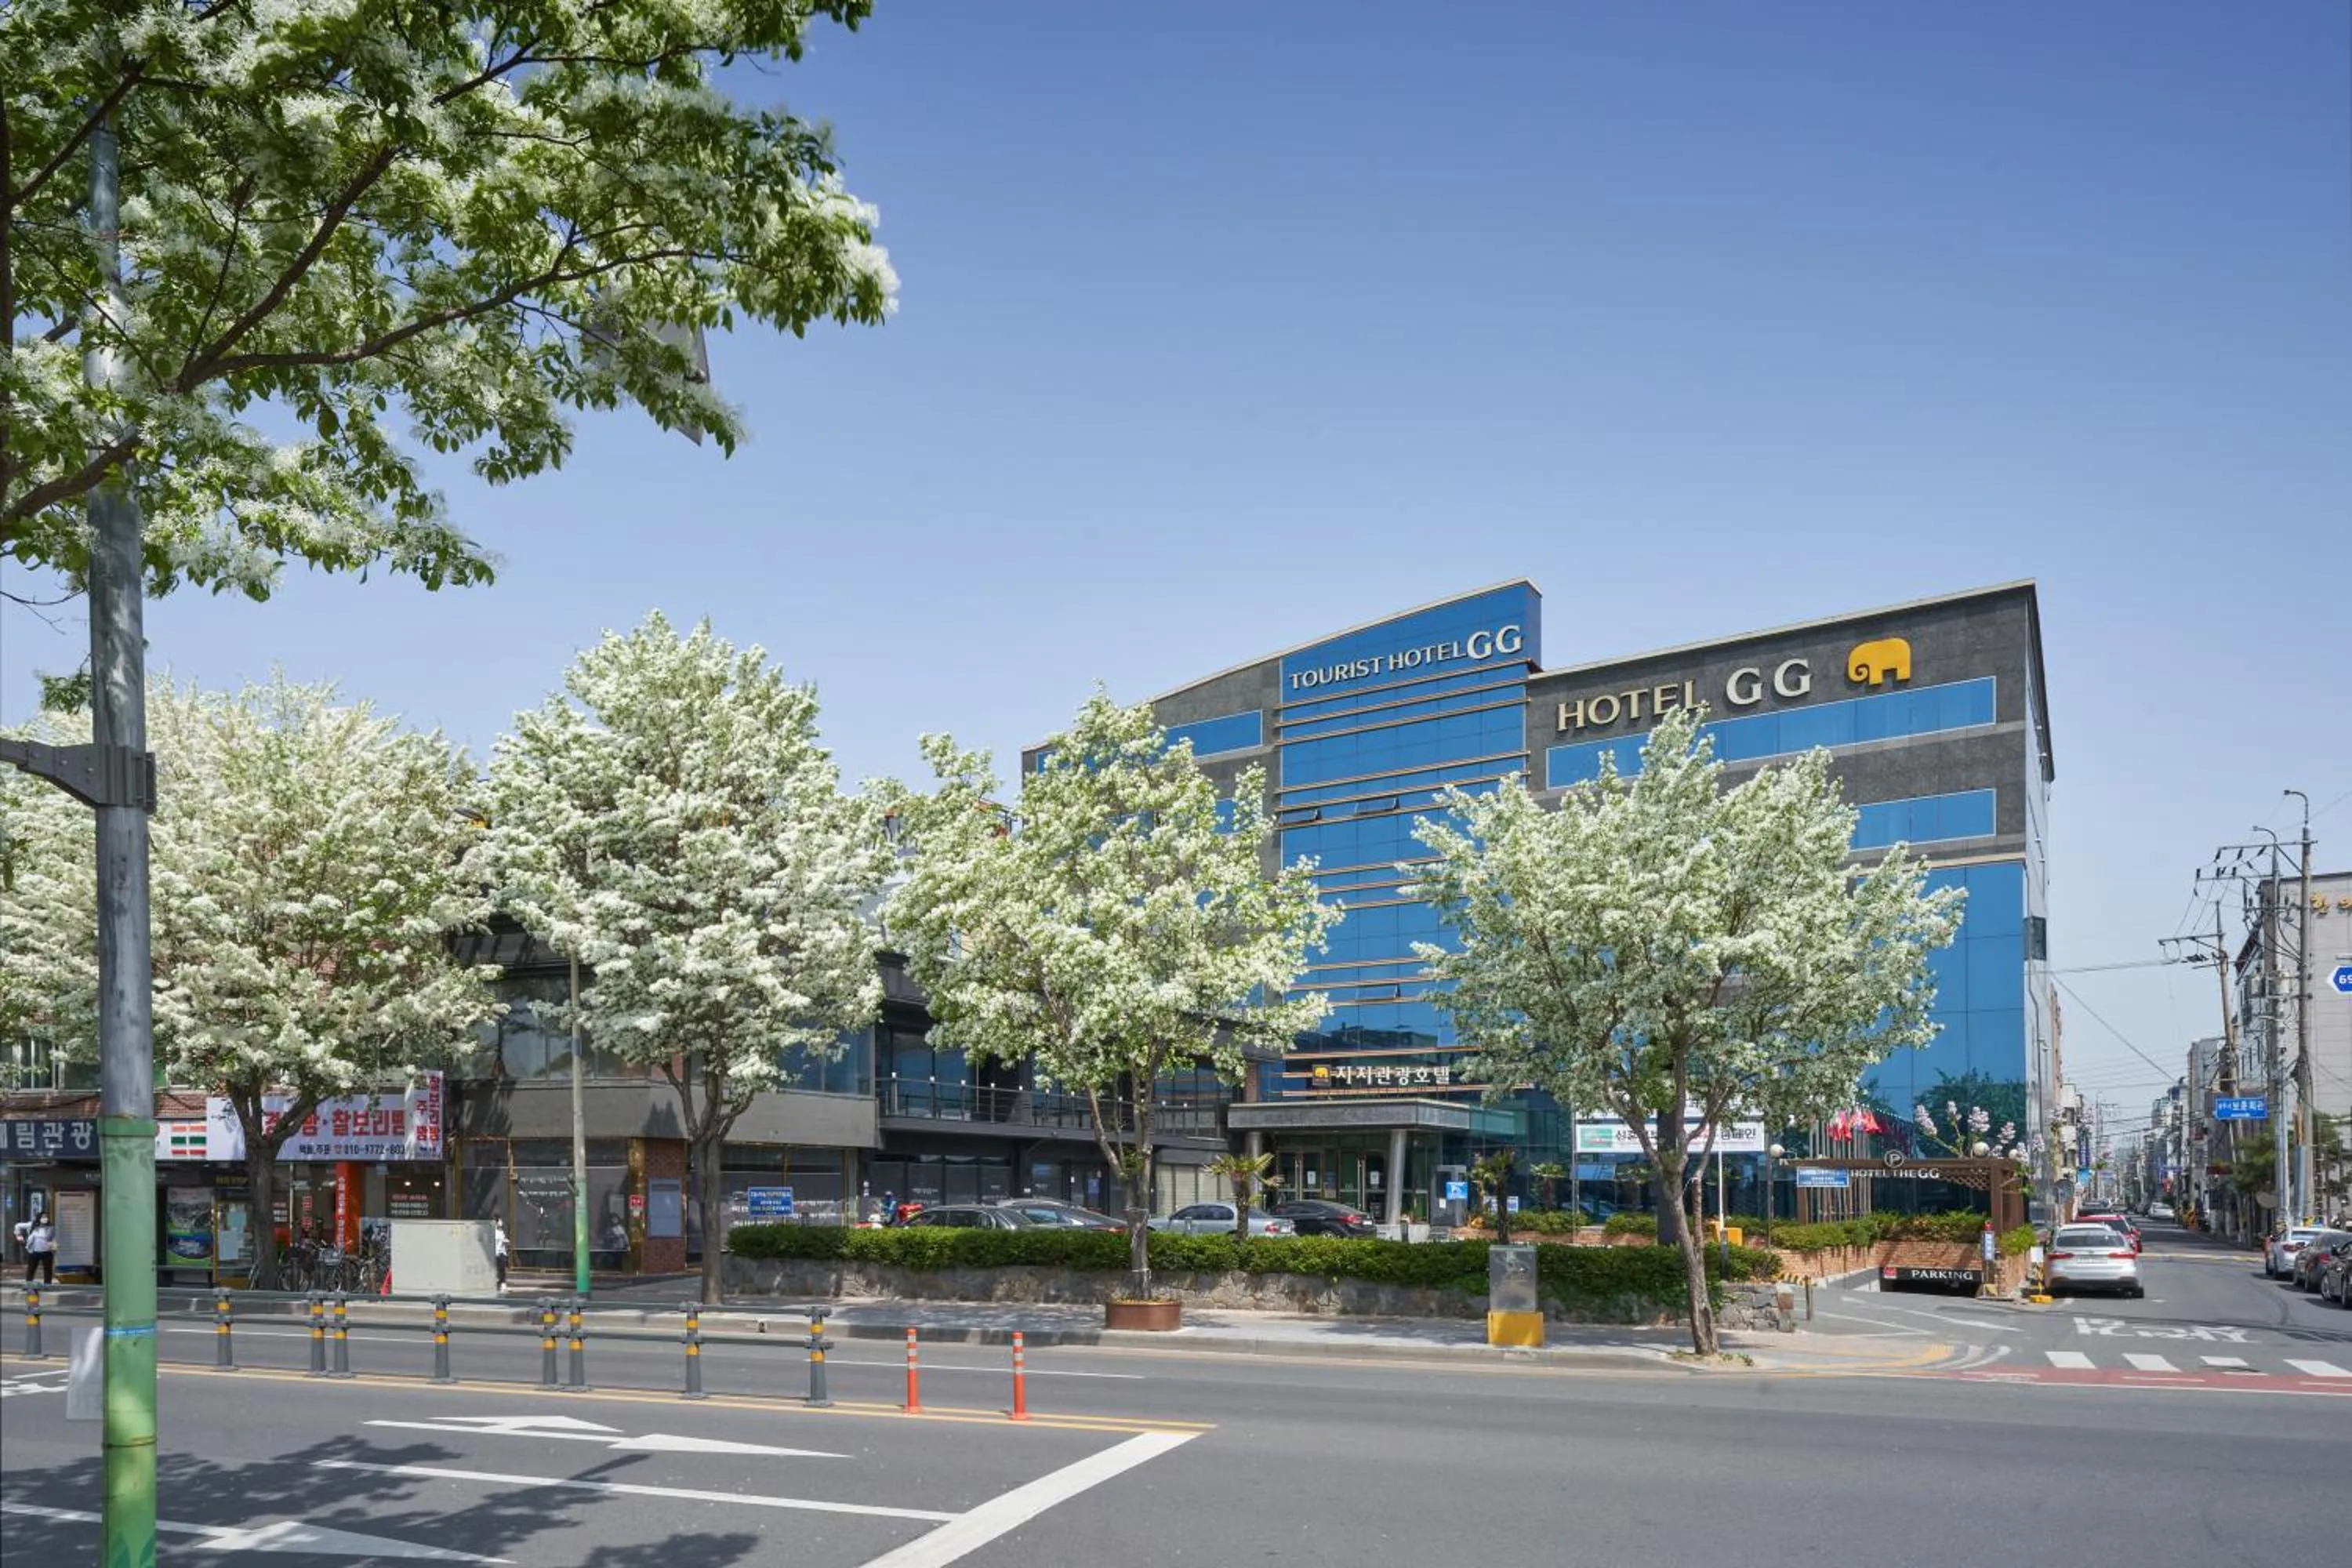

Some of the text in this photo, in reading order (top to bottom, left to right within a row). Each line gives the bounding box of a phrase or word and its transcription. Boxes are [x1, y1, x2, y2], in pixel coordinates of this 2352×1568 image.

[1290, 625, 1523, 689] TOURIST HOTEL GG
[1557, 658, 1813, 731] HOTEL GG
[1335, 1065, 1450, 1086] 지지관광호텔
[1851, 1168, 1889, 1178] HOTEL
[1911, 1269, 1974, 1280] PARKING
